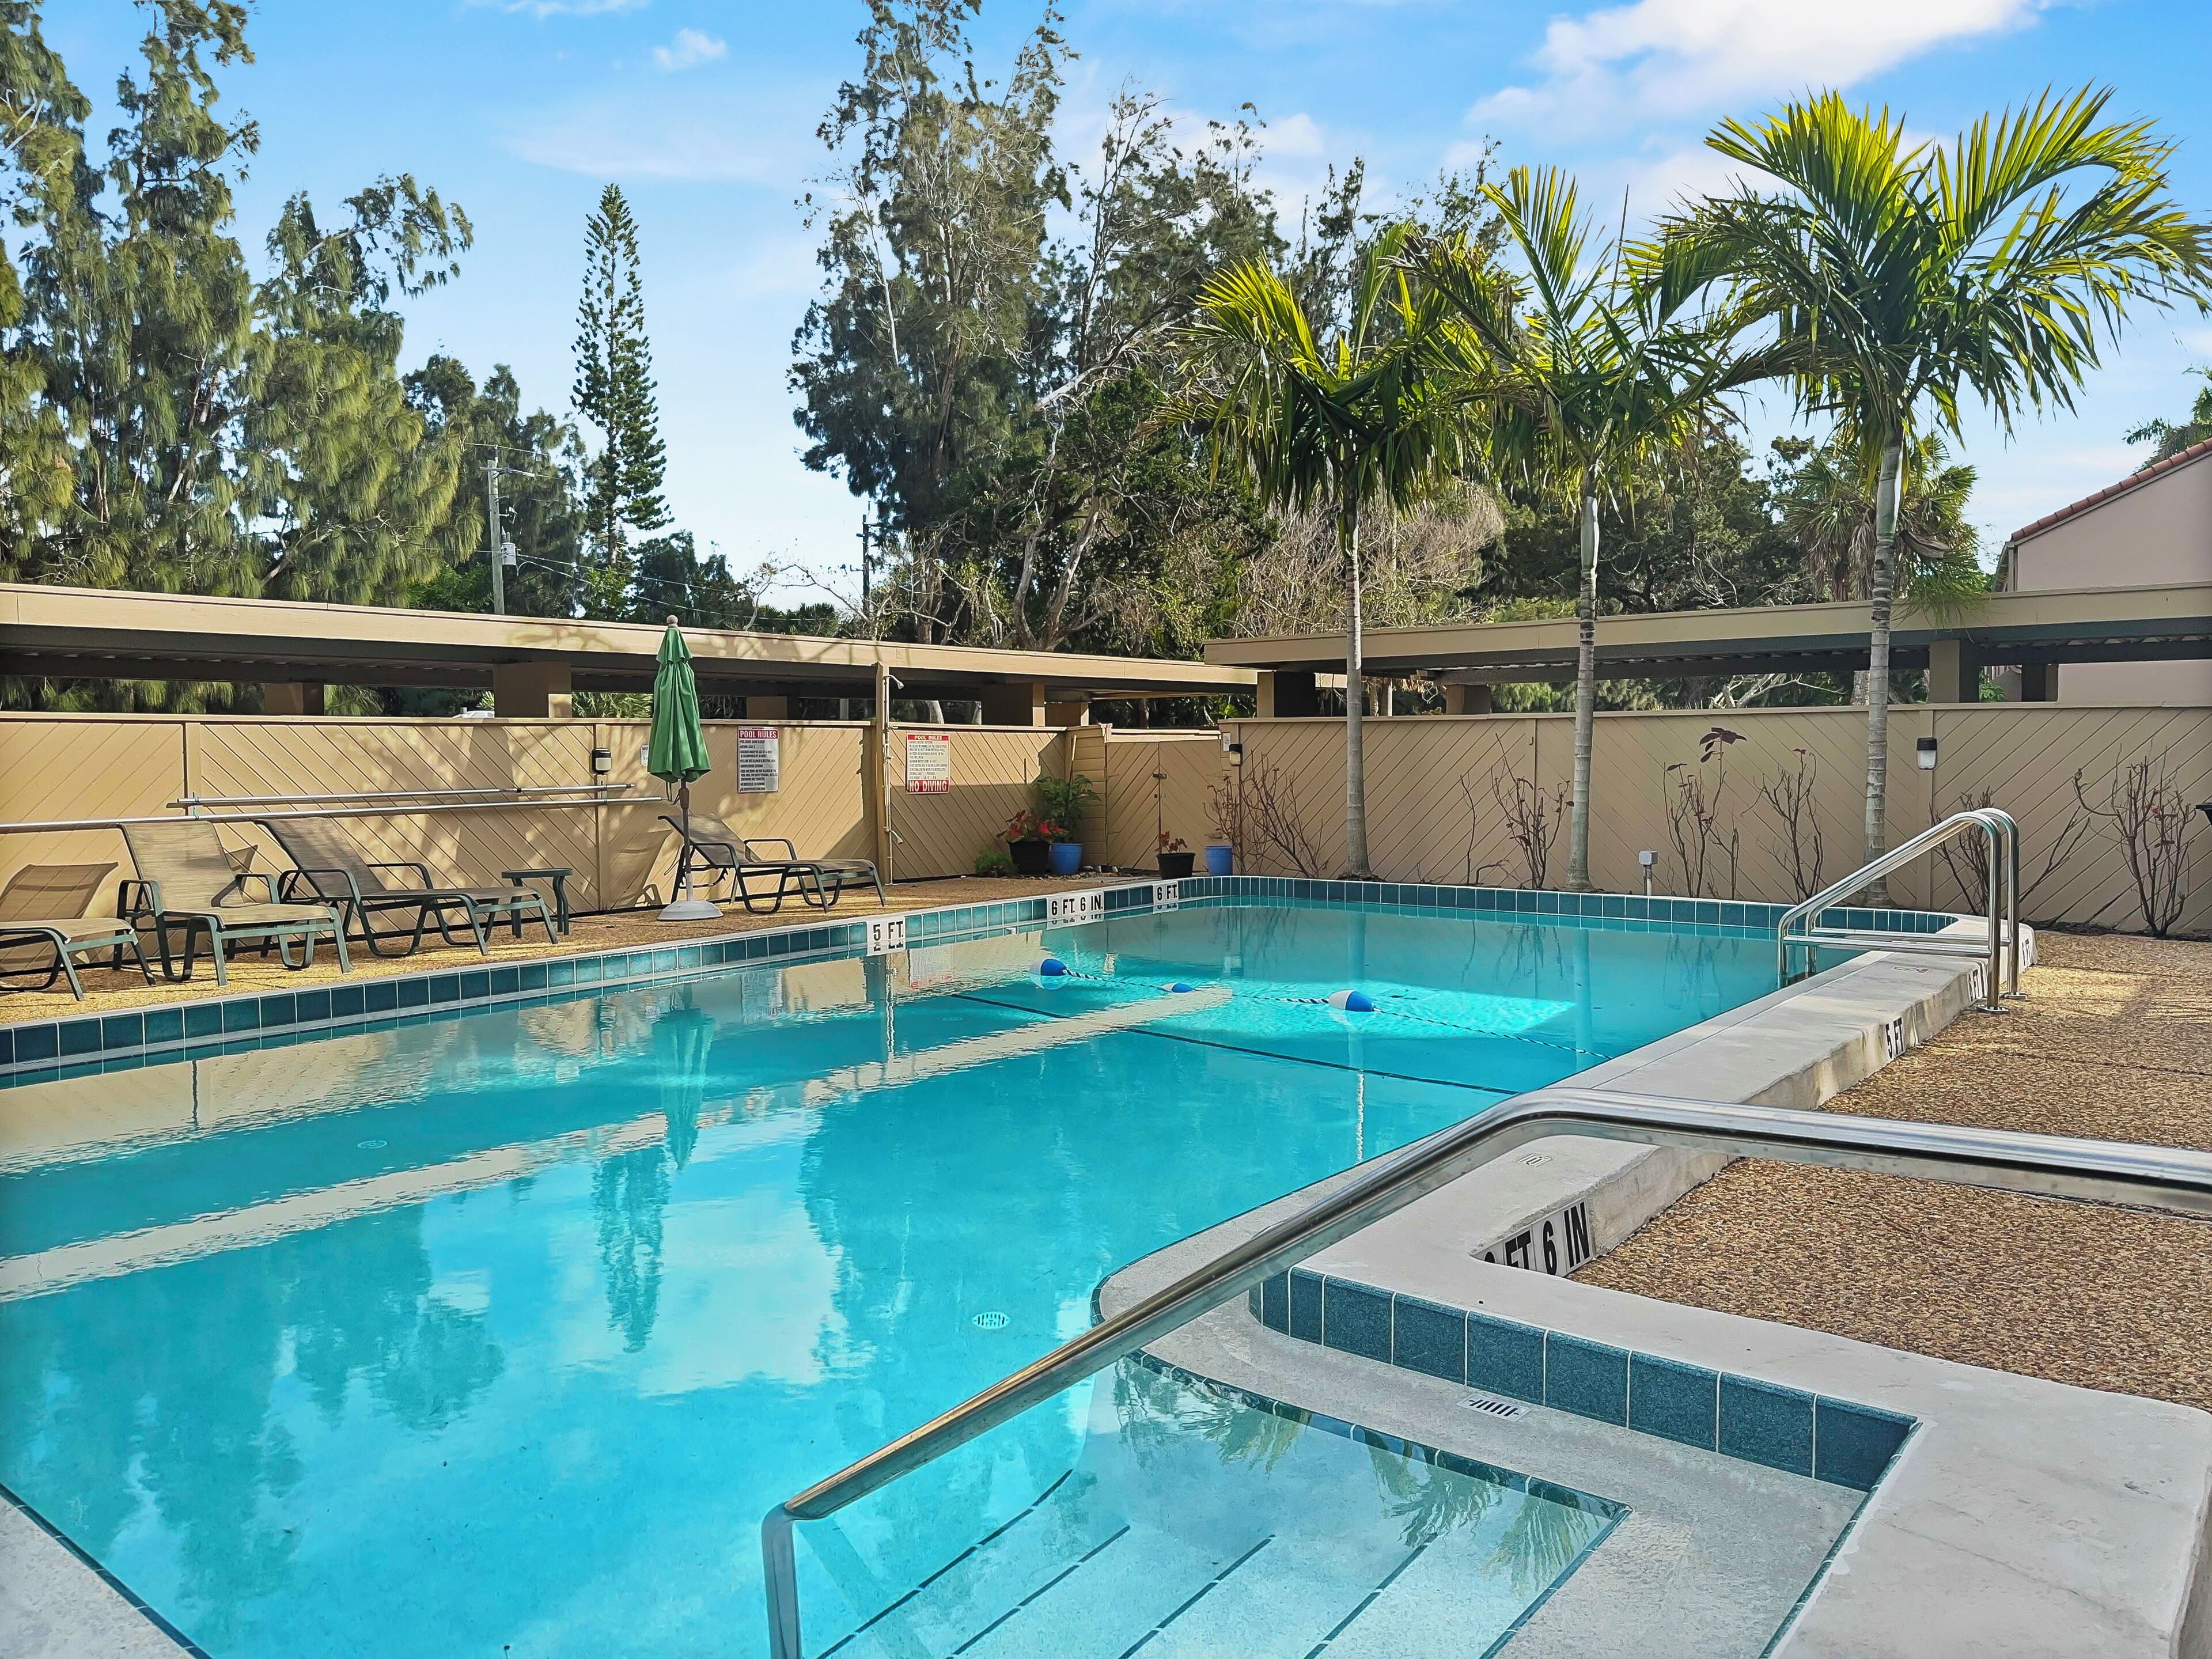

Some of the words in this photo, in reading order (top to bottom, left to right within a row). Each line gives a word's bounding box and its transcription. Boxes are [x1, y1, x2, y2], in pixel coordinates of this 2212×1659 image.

[909, 781, 919, 791] NO
[922, 780, 947, 791] DIVING
[1157, 886, 1162, 901] 6
[1166, 884, 1177, 900] FT.
[1051, 900, 1058, 916] 6
[1063, 899, 1075, 915] FT.
[1080, 896, 1086, 911] 6
[1091, 895, 1103, 911] IN.
[873, 924, 881, 941] 5
[888, 921, 904, 940] FT.
[1885, 1023, 1892, 1059] 5
[1893, 1017, 1903, 1055] FT
[1505, 1229, 1532, 1270] FT
[1543, 1220, 1557, 1276] 6
[1563, 1201, 1590, 1268] IN
